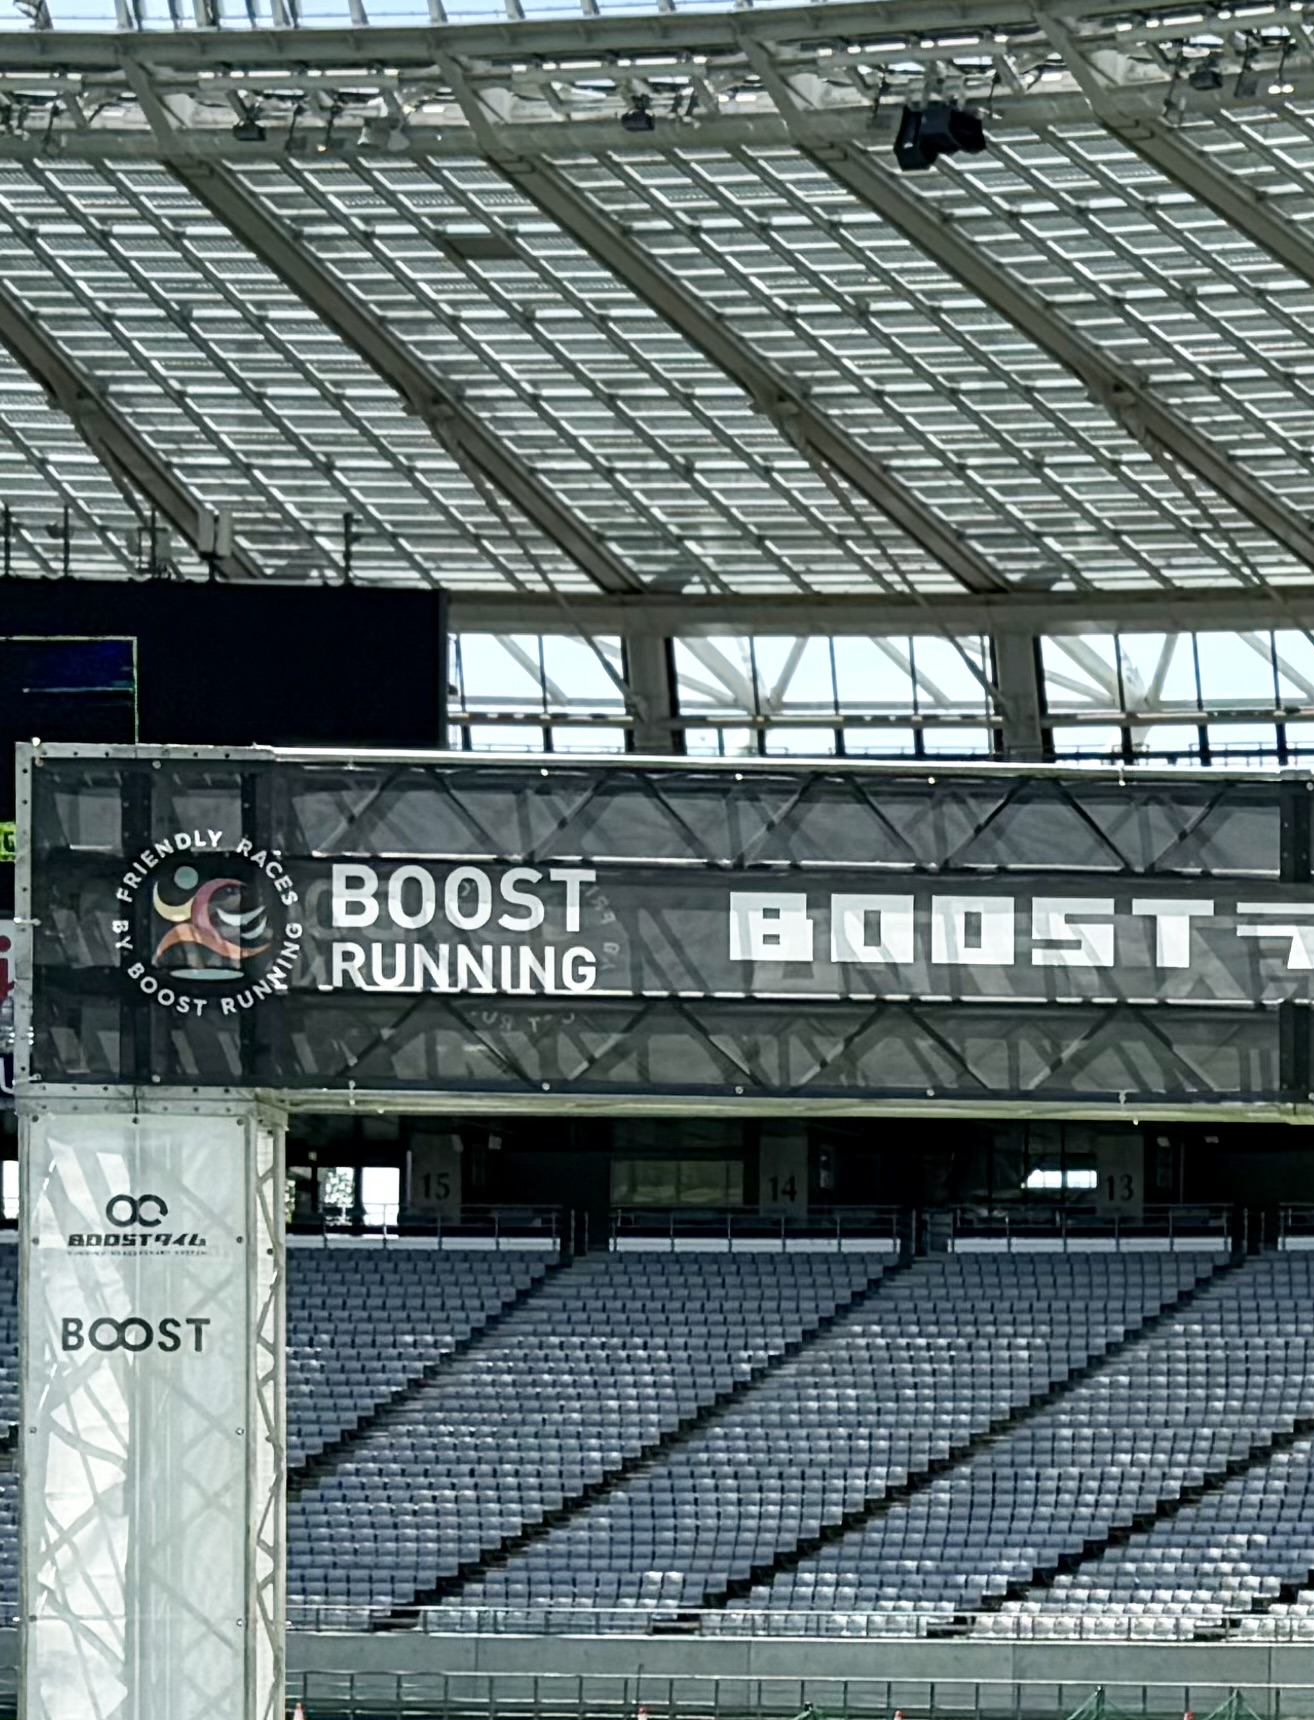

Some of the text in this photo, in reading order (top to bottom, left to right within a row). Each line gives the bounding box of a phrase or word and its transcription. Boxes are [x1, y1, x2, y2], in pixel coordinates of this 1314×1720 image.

[117, 829, 298, 907] FRIENDLY RACES
[331, 863, 597, 932] BOOST
[111, 920, 303, 1016] BY BOOST RUNNING
[332, 941, 597, 992] RUNNING
[421, 1173, 450, 1201] 15
[769, 1174, 798, 1203] 14
[1106, 1173, 1134, 1202] 13
[61, 1316, 212, 1353] BOOST
